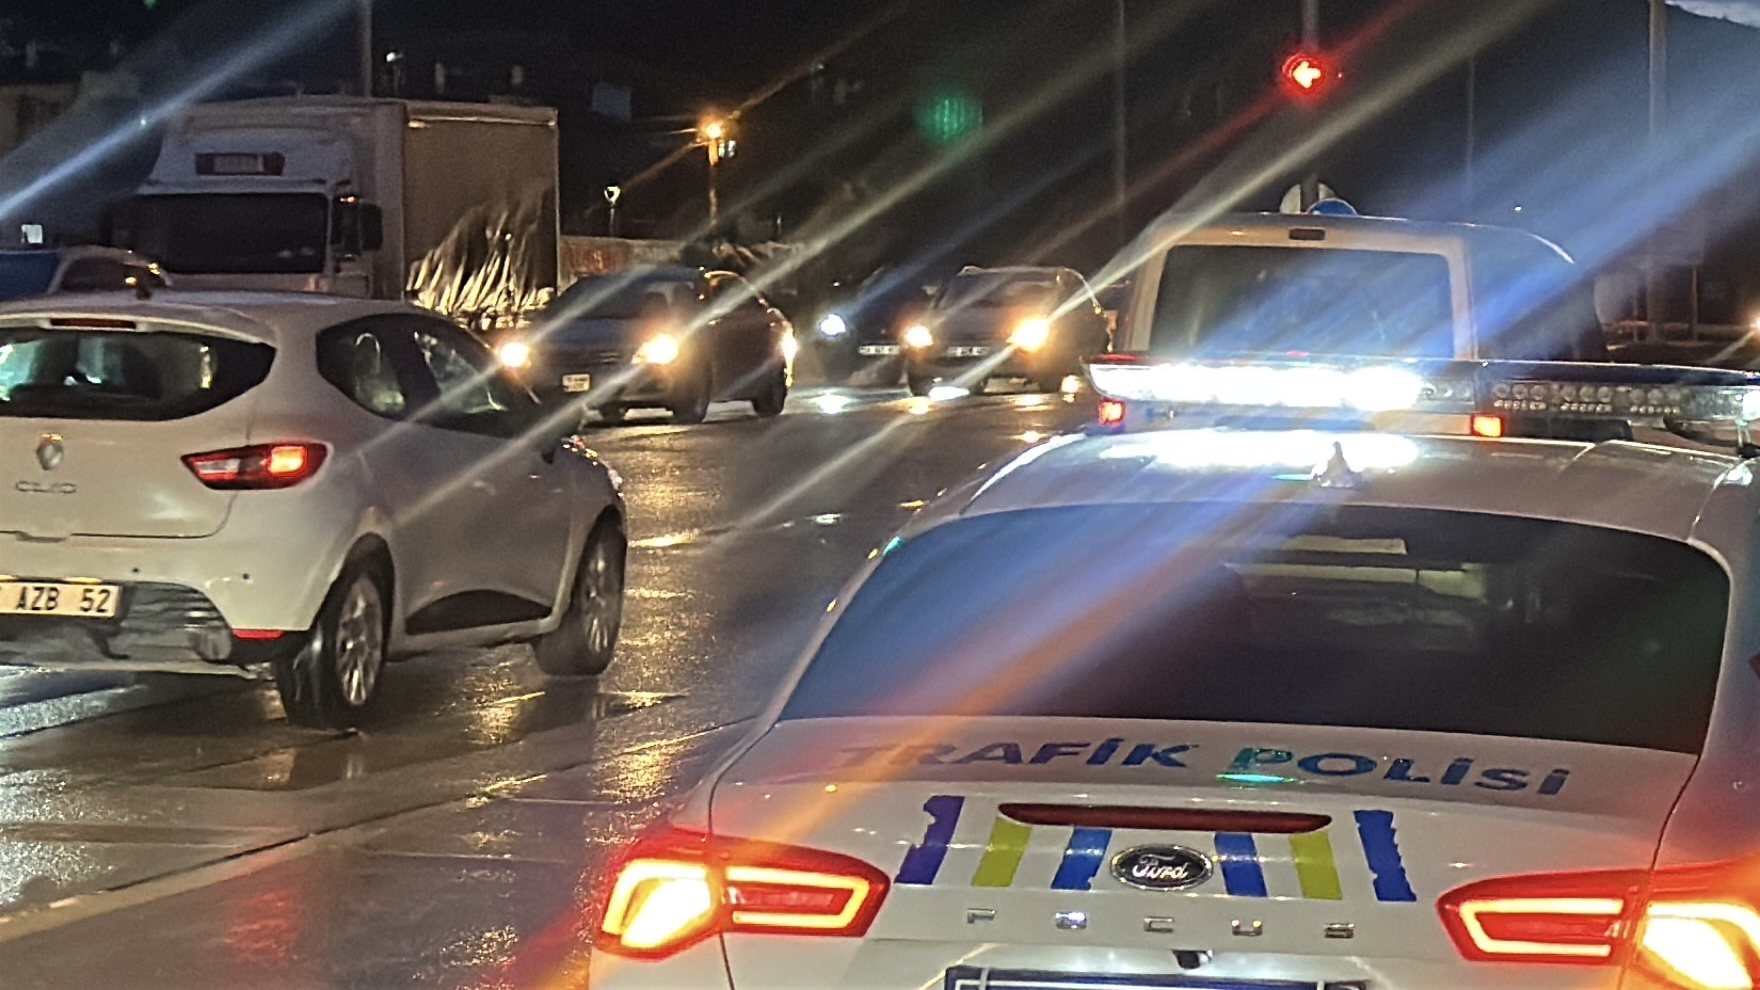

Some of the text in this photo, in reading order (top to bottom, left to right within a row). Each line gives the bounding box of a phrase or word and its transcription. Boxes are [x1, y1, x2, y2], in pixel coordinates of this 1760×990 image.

[16, 586, 60, 611] AZB
[80, 588, 111, 613] 52
[1132, 853, 1190, 880] Ford
